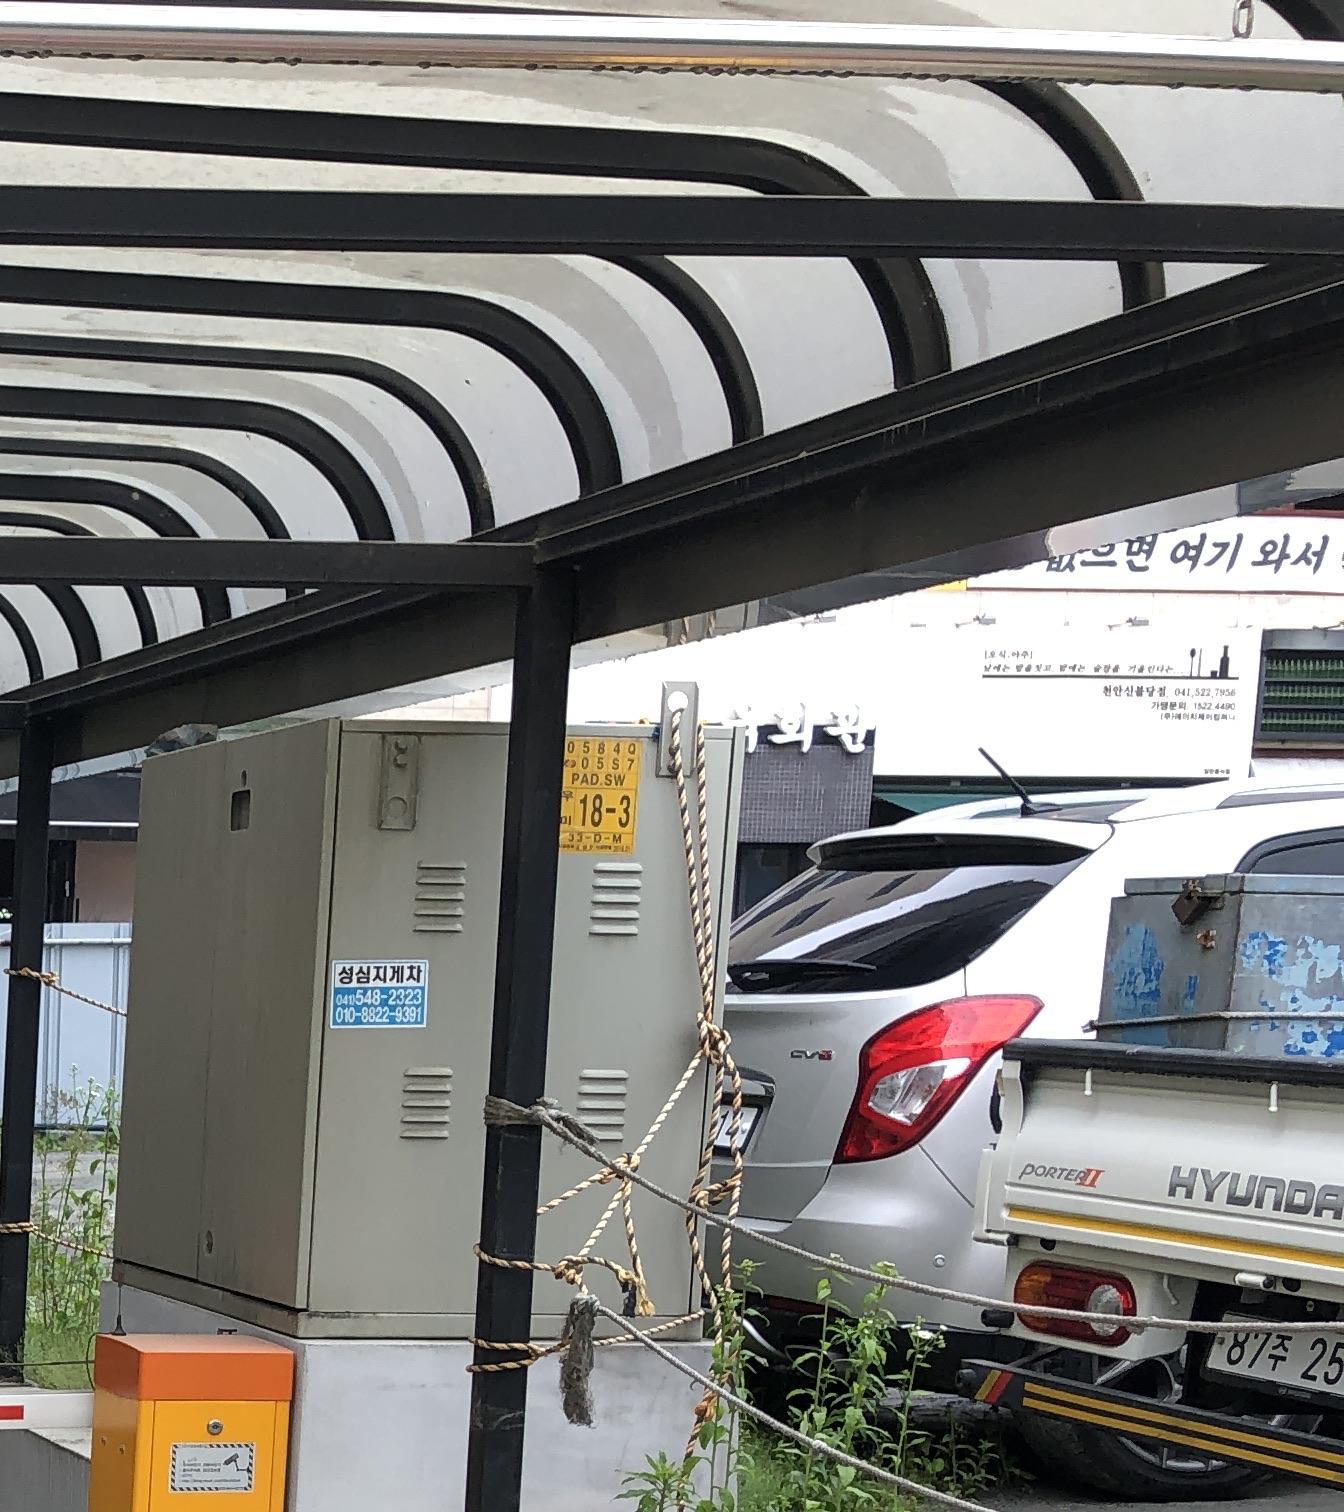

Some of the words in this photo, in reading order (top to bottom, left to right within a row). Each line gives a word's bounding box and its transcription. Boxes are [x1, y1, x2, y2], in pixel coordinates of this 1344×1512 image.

[1169, 532, 1243, 574] 여기
[1251, 532, 1330, 575] 와서
[571, 772, 626, 787] PAD.SW
[579, 793, 631, 828] 18-3
[338, 965, 423, 984] 성심지게차
[335, 1006, 422, 1023] 010-8822-9391
